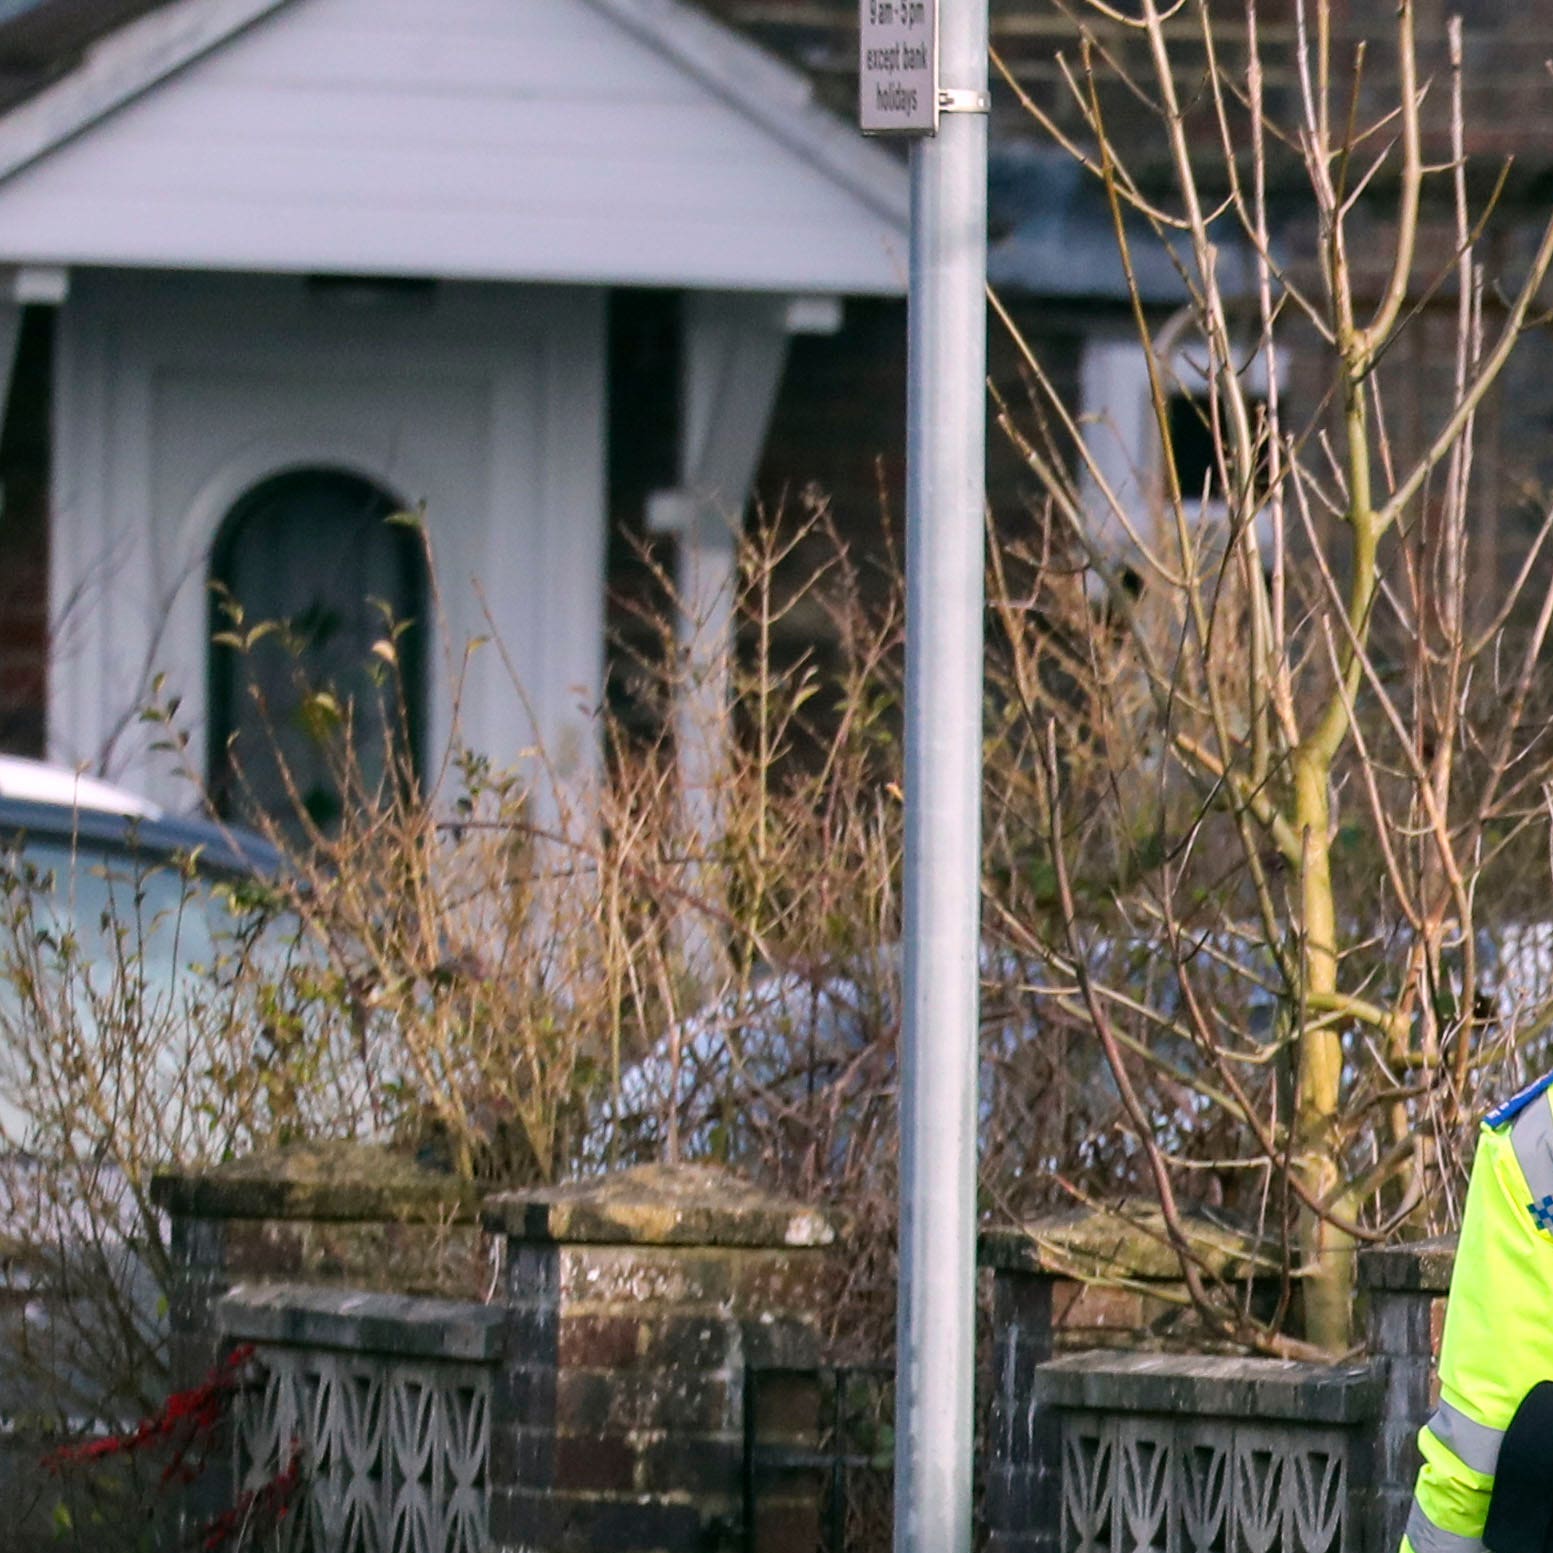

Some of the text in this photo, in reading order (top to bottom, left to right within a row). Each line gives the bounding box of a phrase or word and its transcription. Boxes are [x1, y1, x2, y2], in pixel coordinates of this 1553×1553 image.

[867, 42, 927, 76] except bank
[876, 82, 918, 117] holidays
